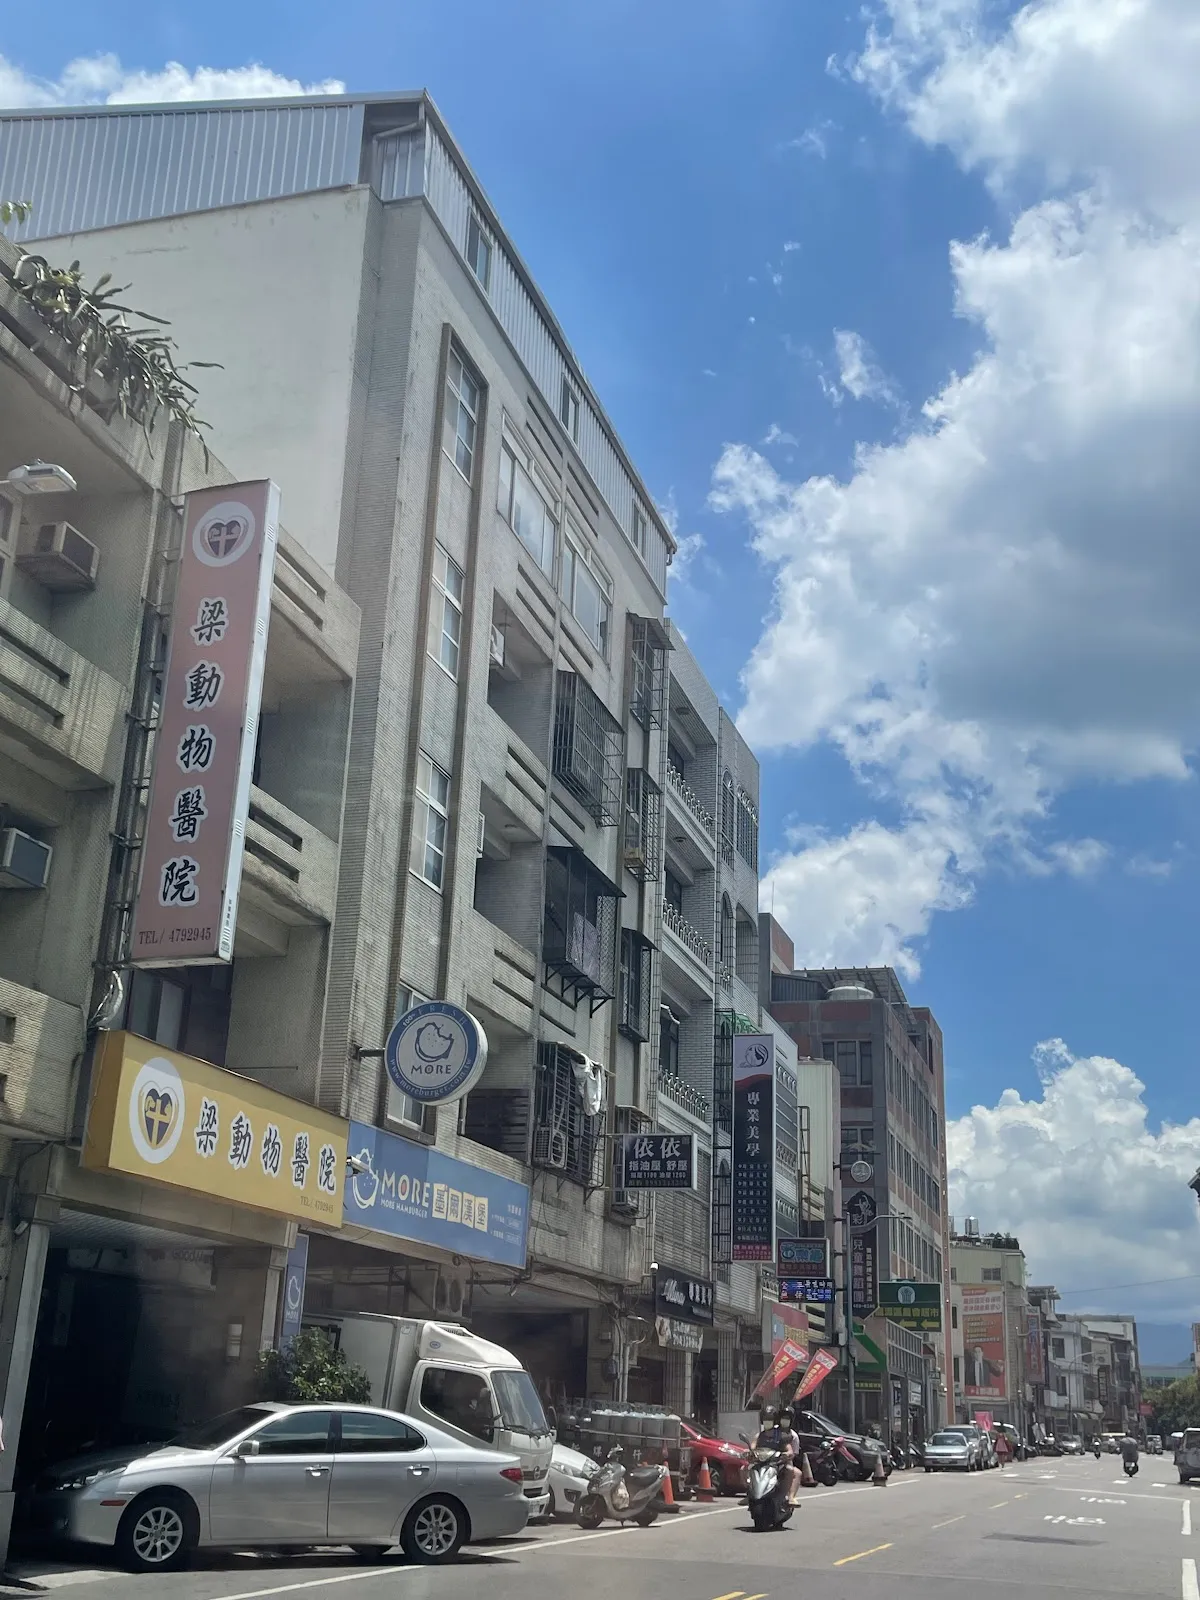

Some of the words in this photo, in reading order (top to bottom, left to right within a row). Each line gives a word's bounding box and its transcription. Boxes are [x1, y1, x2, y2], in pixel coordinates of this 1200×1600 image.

[162, 599, 226, 904] 梁動物醫院
[168, 926, 212, 944] 4792945
[419, 1004, 468, 1026] FRESH
[390, 1058, 472, 1097] www.moreburger.com.tw
[410, 1064, 452, 1075] MORE
[745, 1090, 761, 1157] 專業美學
[194, 1101, 337, 1192] 梁動物醫院
[633, 1137, 682, 1159] 依依
[628, 1160, 661, 1171] 指油壓
[381, 1169, 431, 1208] MORE
[380, 1198, 396, 1211] MORE
[396, 1203, 428, 1219] HAMBURGER
